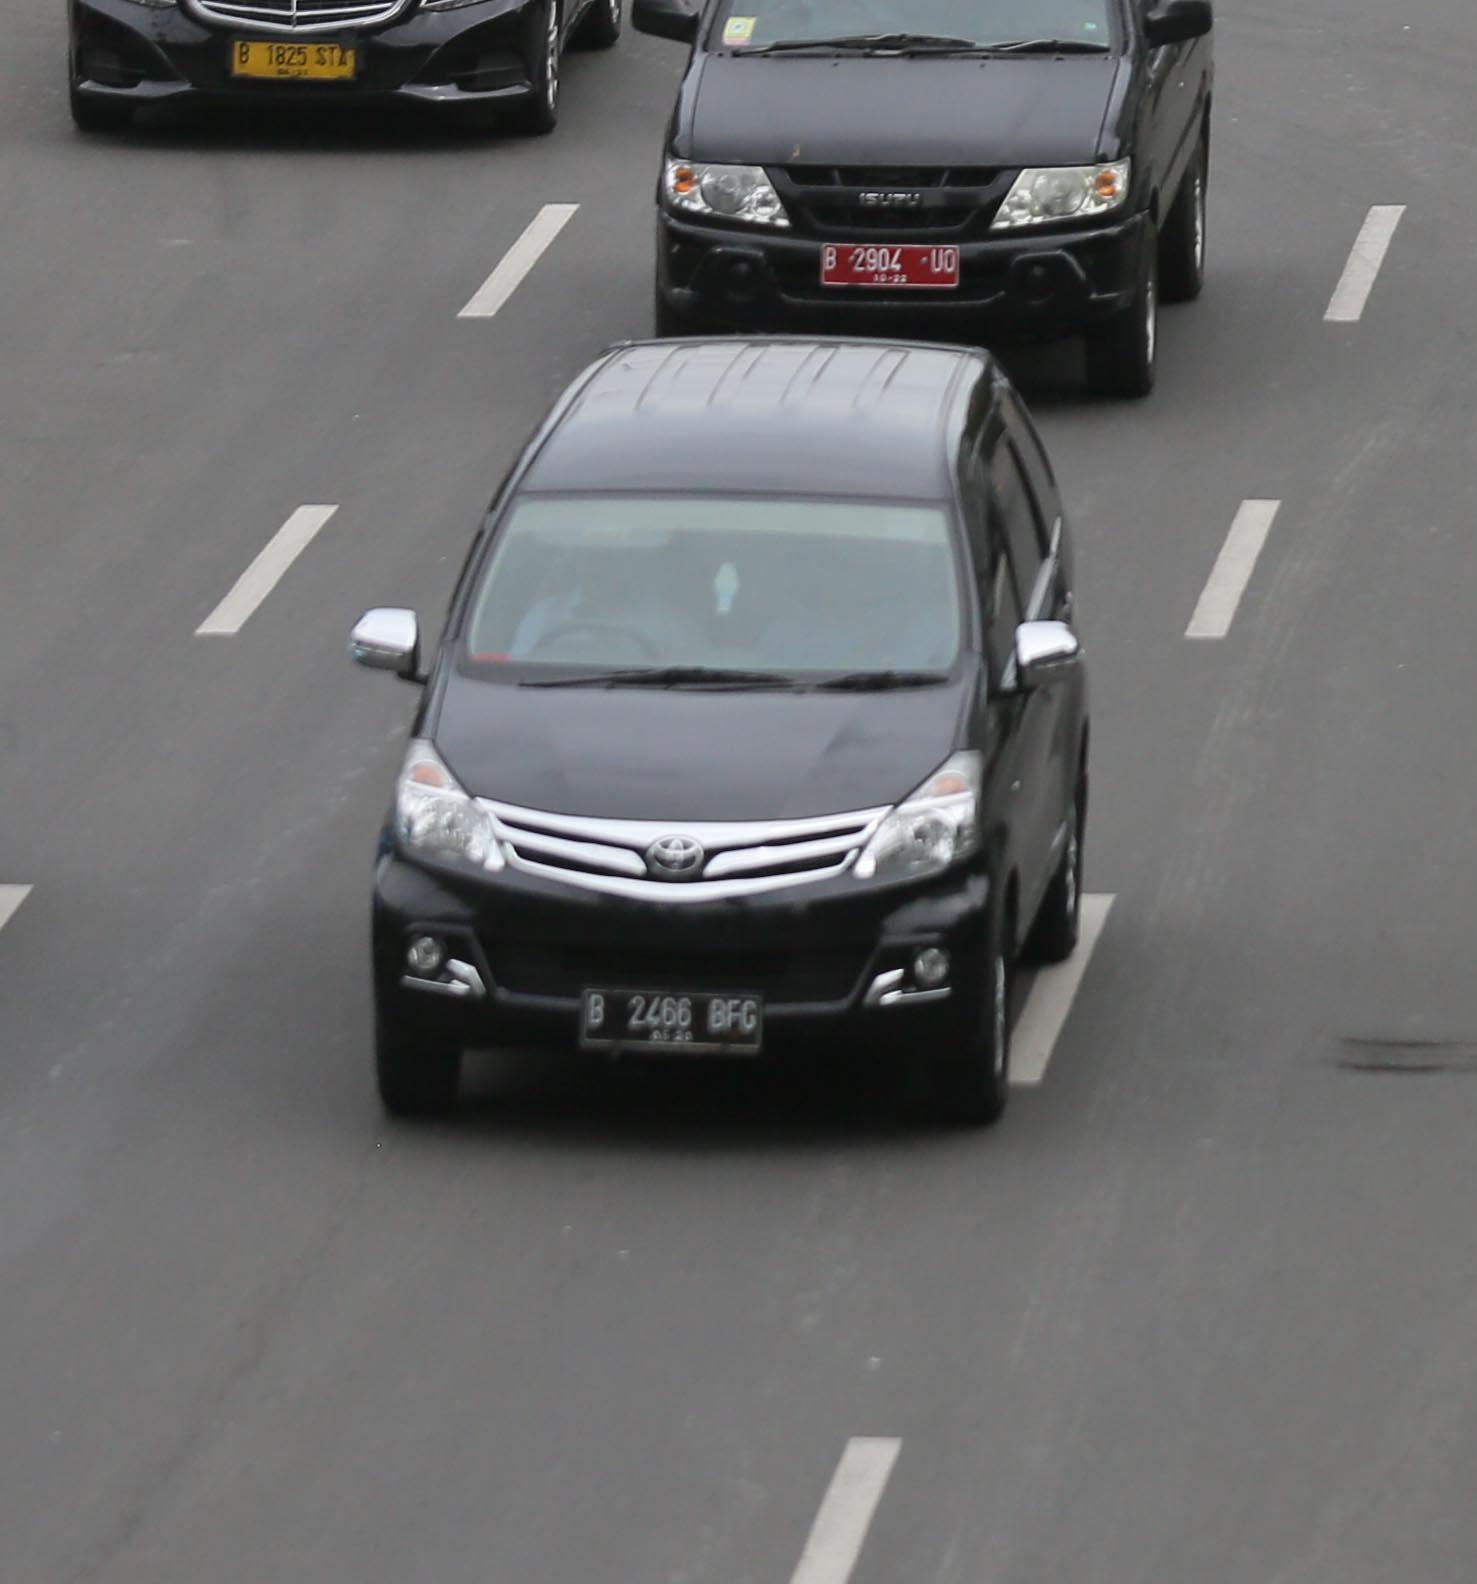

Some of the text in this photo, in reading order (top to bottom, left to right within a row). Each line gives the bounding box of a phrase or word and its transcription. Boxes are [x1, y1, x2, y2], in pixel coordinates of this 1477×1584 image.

[239, 43, 251, 64] B
[267, 44, 309, 66] 1825
[859, 193, 921, 206] ISUZU
[826, 248, 837, 271] B
[853, 248, 903, 272] 2904
[590, 993, 758, 1032] B 2466 BFG
